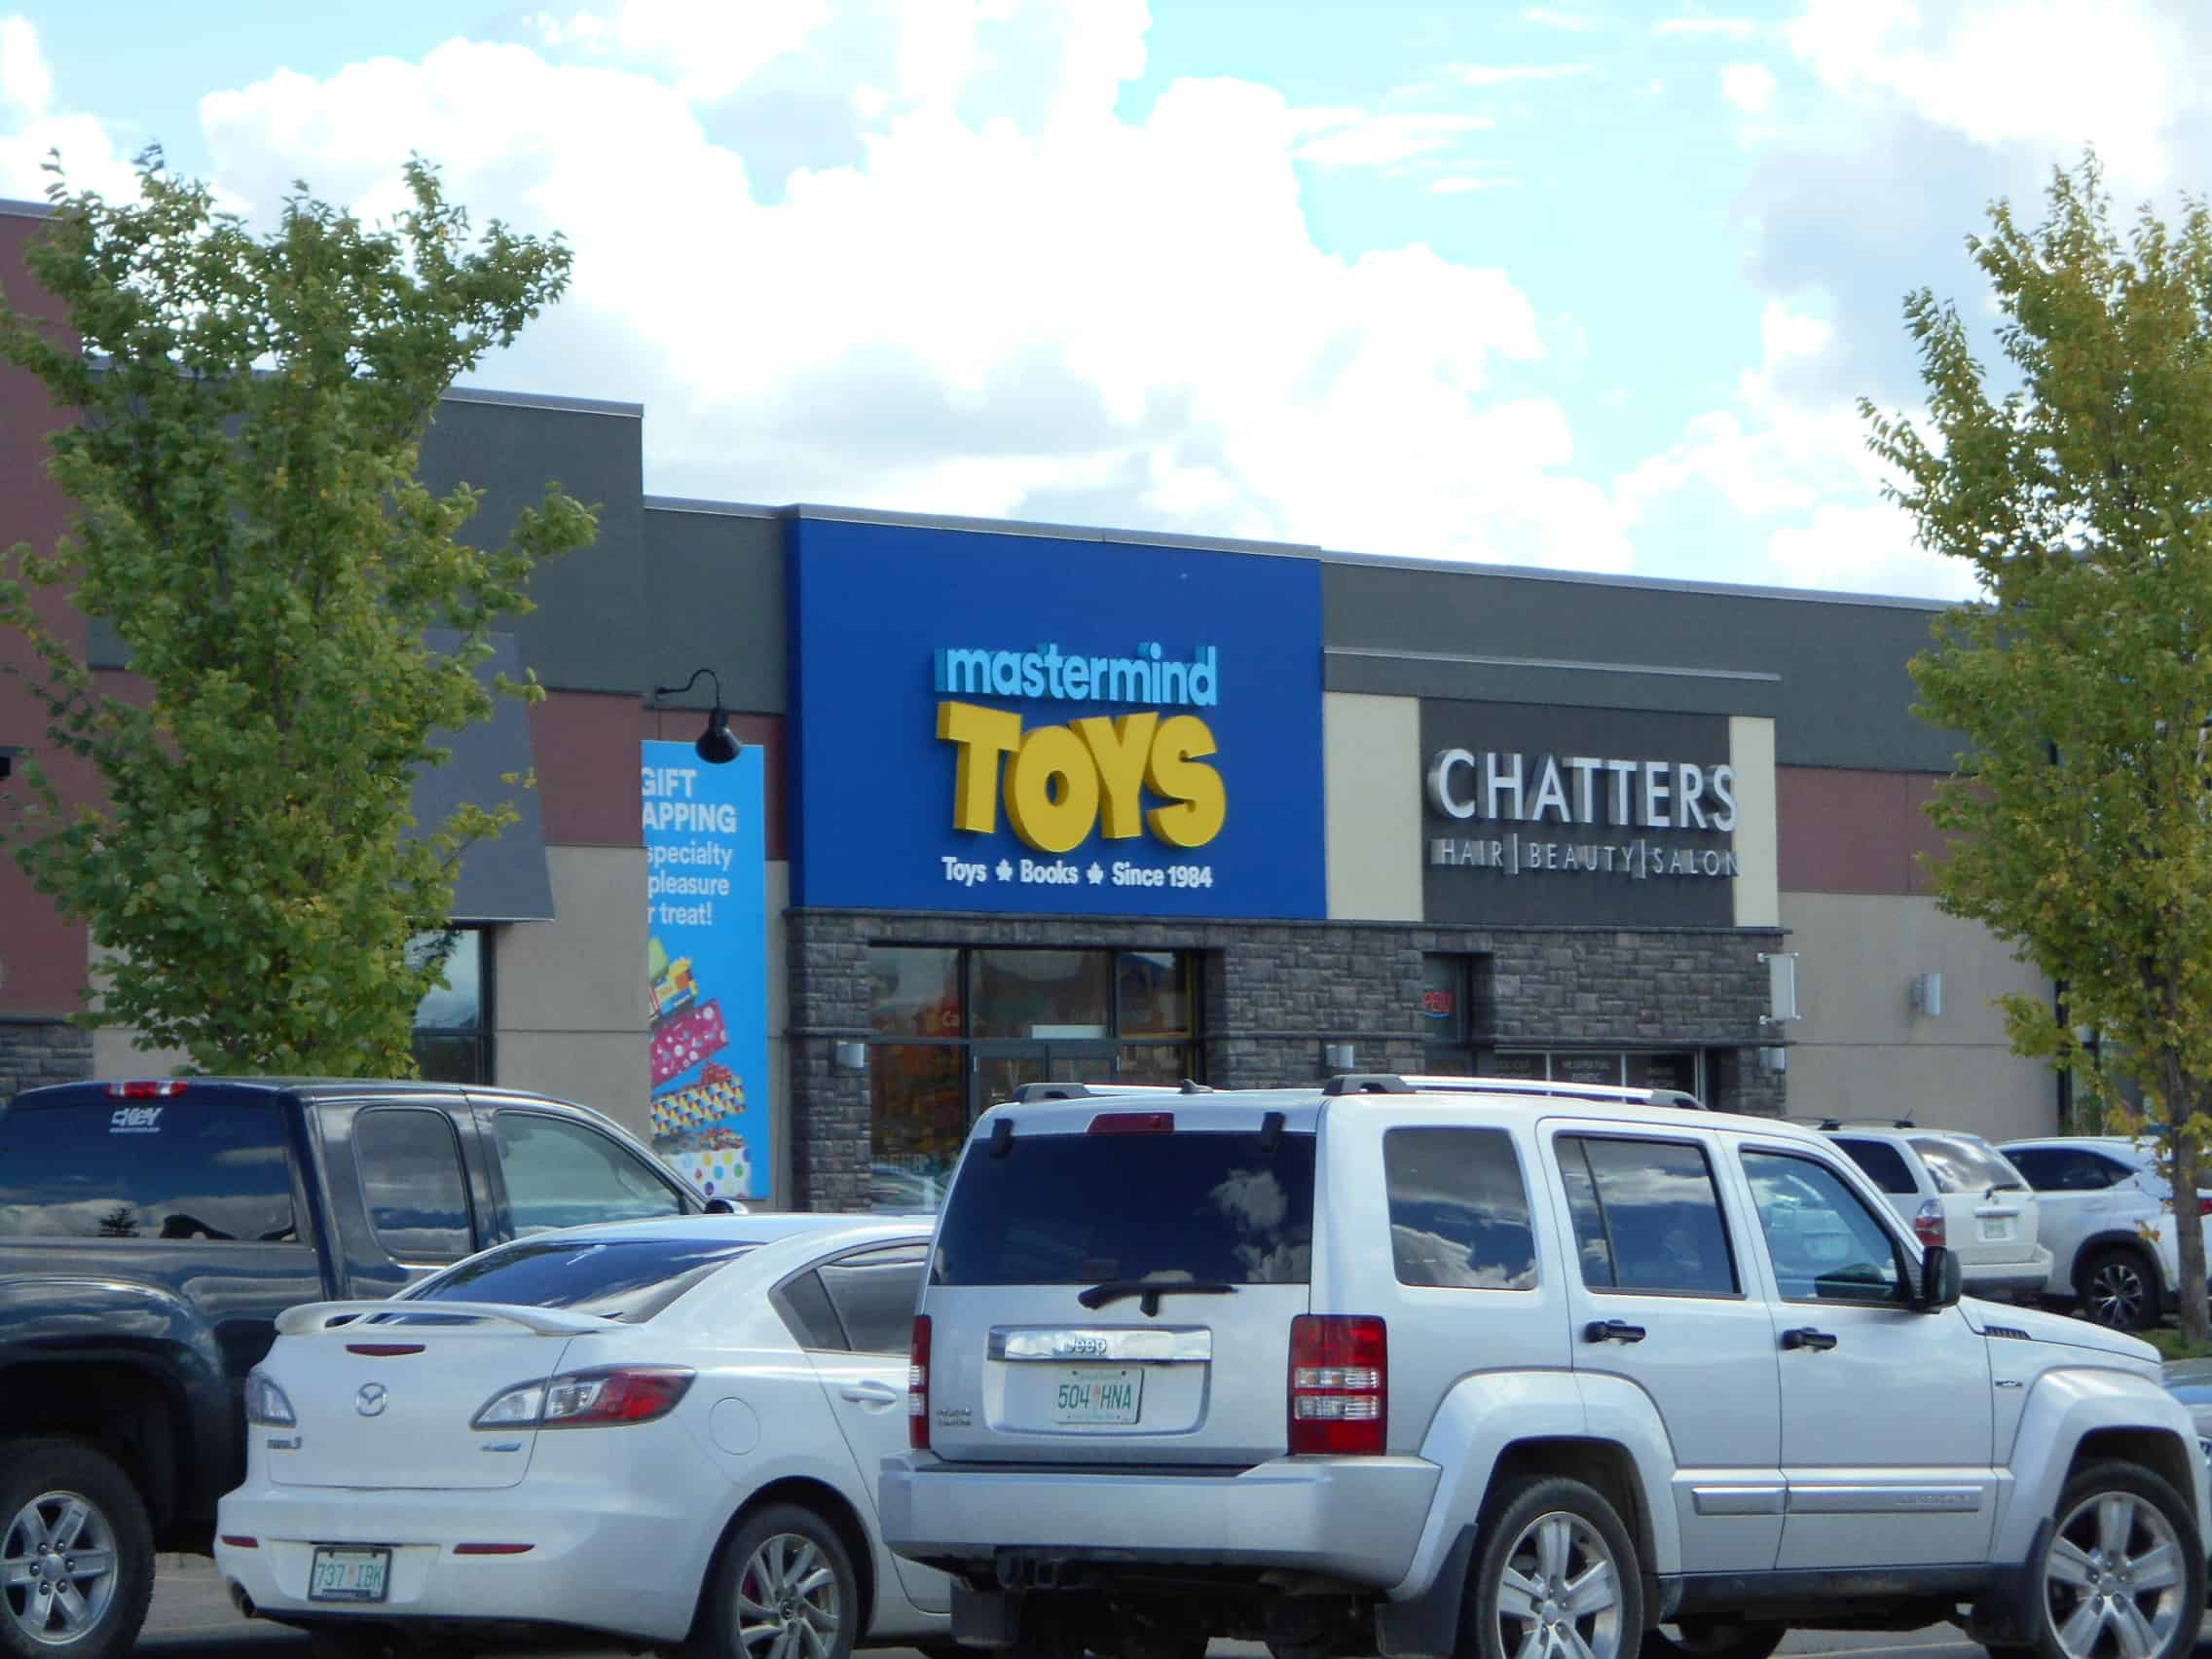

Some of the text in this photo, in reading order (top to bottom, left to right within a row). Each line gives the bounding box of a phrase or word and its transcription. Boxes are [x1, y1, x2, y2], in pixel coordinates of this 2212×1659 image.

[937, 643, 1217, 707] mastermind
[642, 767, 697, 797] GIFT
[937, 700, 1227, 853] TOYS
[1428, 748, 1739, 831] CHATTERS
[941, 856, 1214, 888] Toys Books Since 1984
[1434, 838, 1740, 877] HAIR BEAUTY SALON
[647, 869, 730, 899] pleasure
[659, 902, 713, 926] treat!
